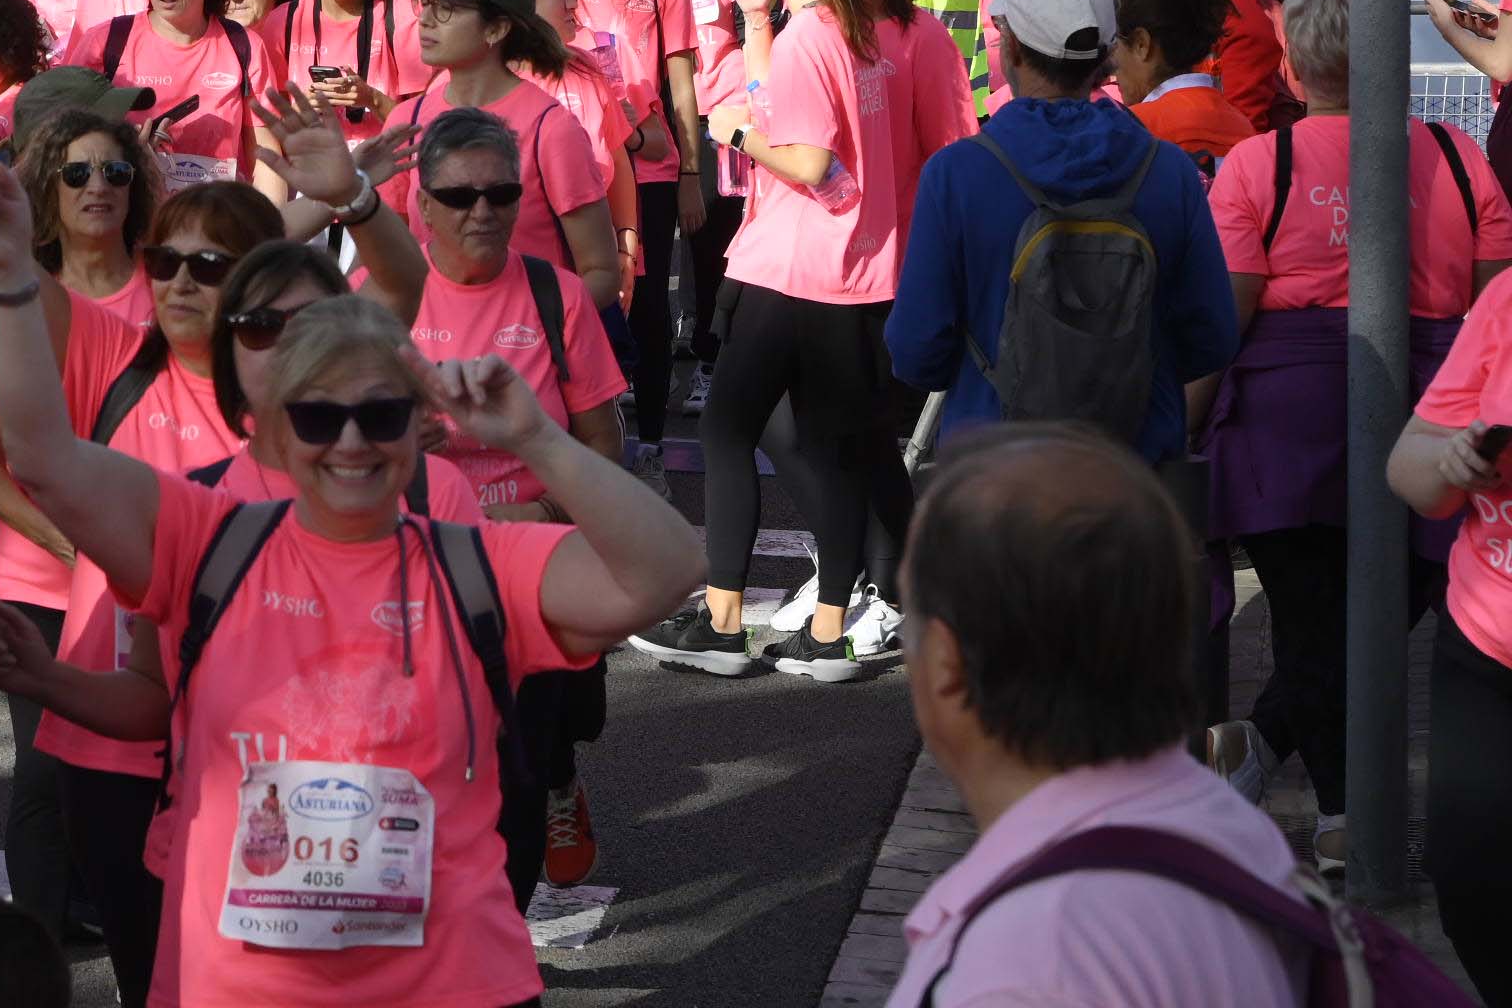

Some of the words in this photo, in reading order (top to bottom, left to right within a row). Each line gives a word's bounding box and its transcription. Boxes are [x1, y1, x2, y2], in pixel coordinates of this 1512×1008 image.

[478, 481, 519, 505] 2019
[295, 793, 368, 813] ASTURIANA
[294, 835, 360, 863] 016
[302, 871, 345, 888] 4036
[248, 893, 298, 906] CARRERA
[301, 894, 317, 906] DE
[318, 895, 334, 907] LA
[336, 896, 378, 908] MUJER
[238, 916, 299, 934] OYSHO
